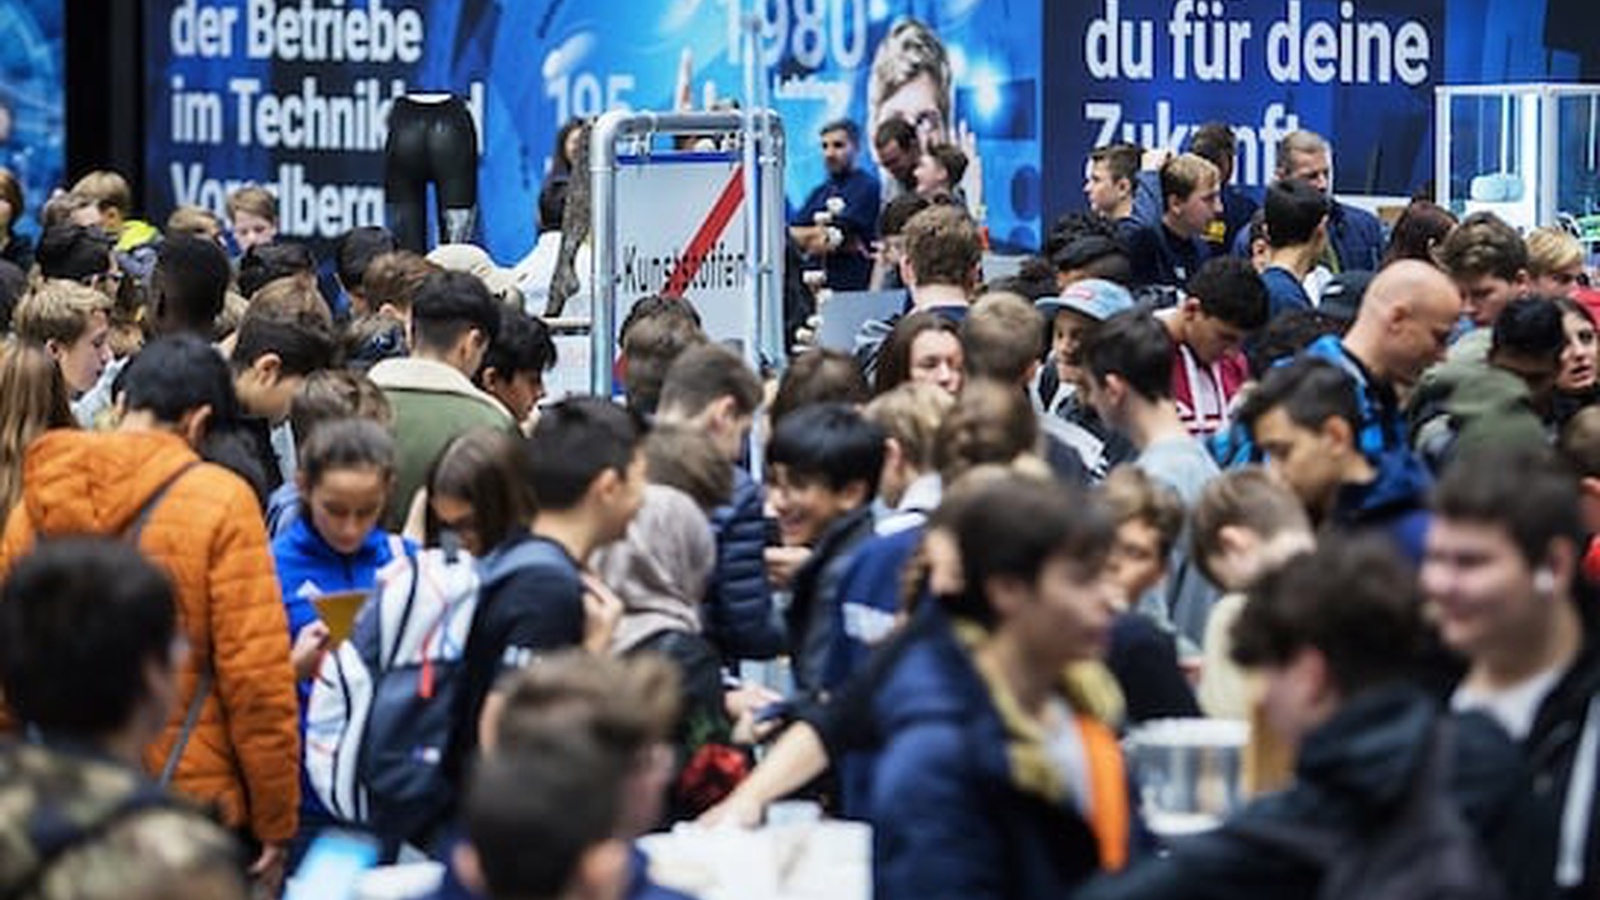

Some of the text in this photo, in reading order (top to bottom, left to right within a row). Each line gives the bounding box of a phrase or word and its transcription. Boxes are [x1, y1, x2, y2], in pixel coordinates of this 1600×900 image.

[170, 0, 424, 62] der Betriebe
[1085, 0, 1431, 85] du für deine
[171, 75, 223, 143] im
